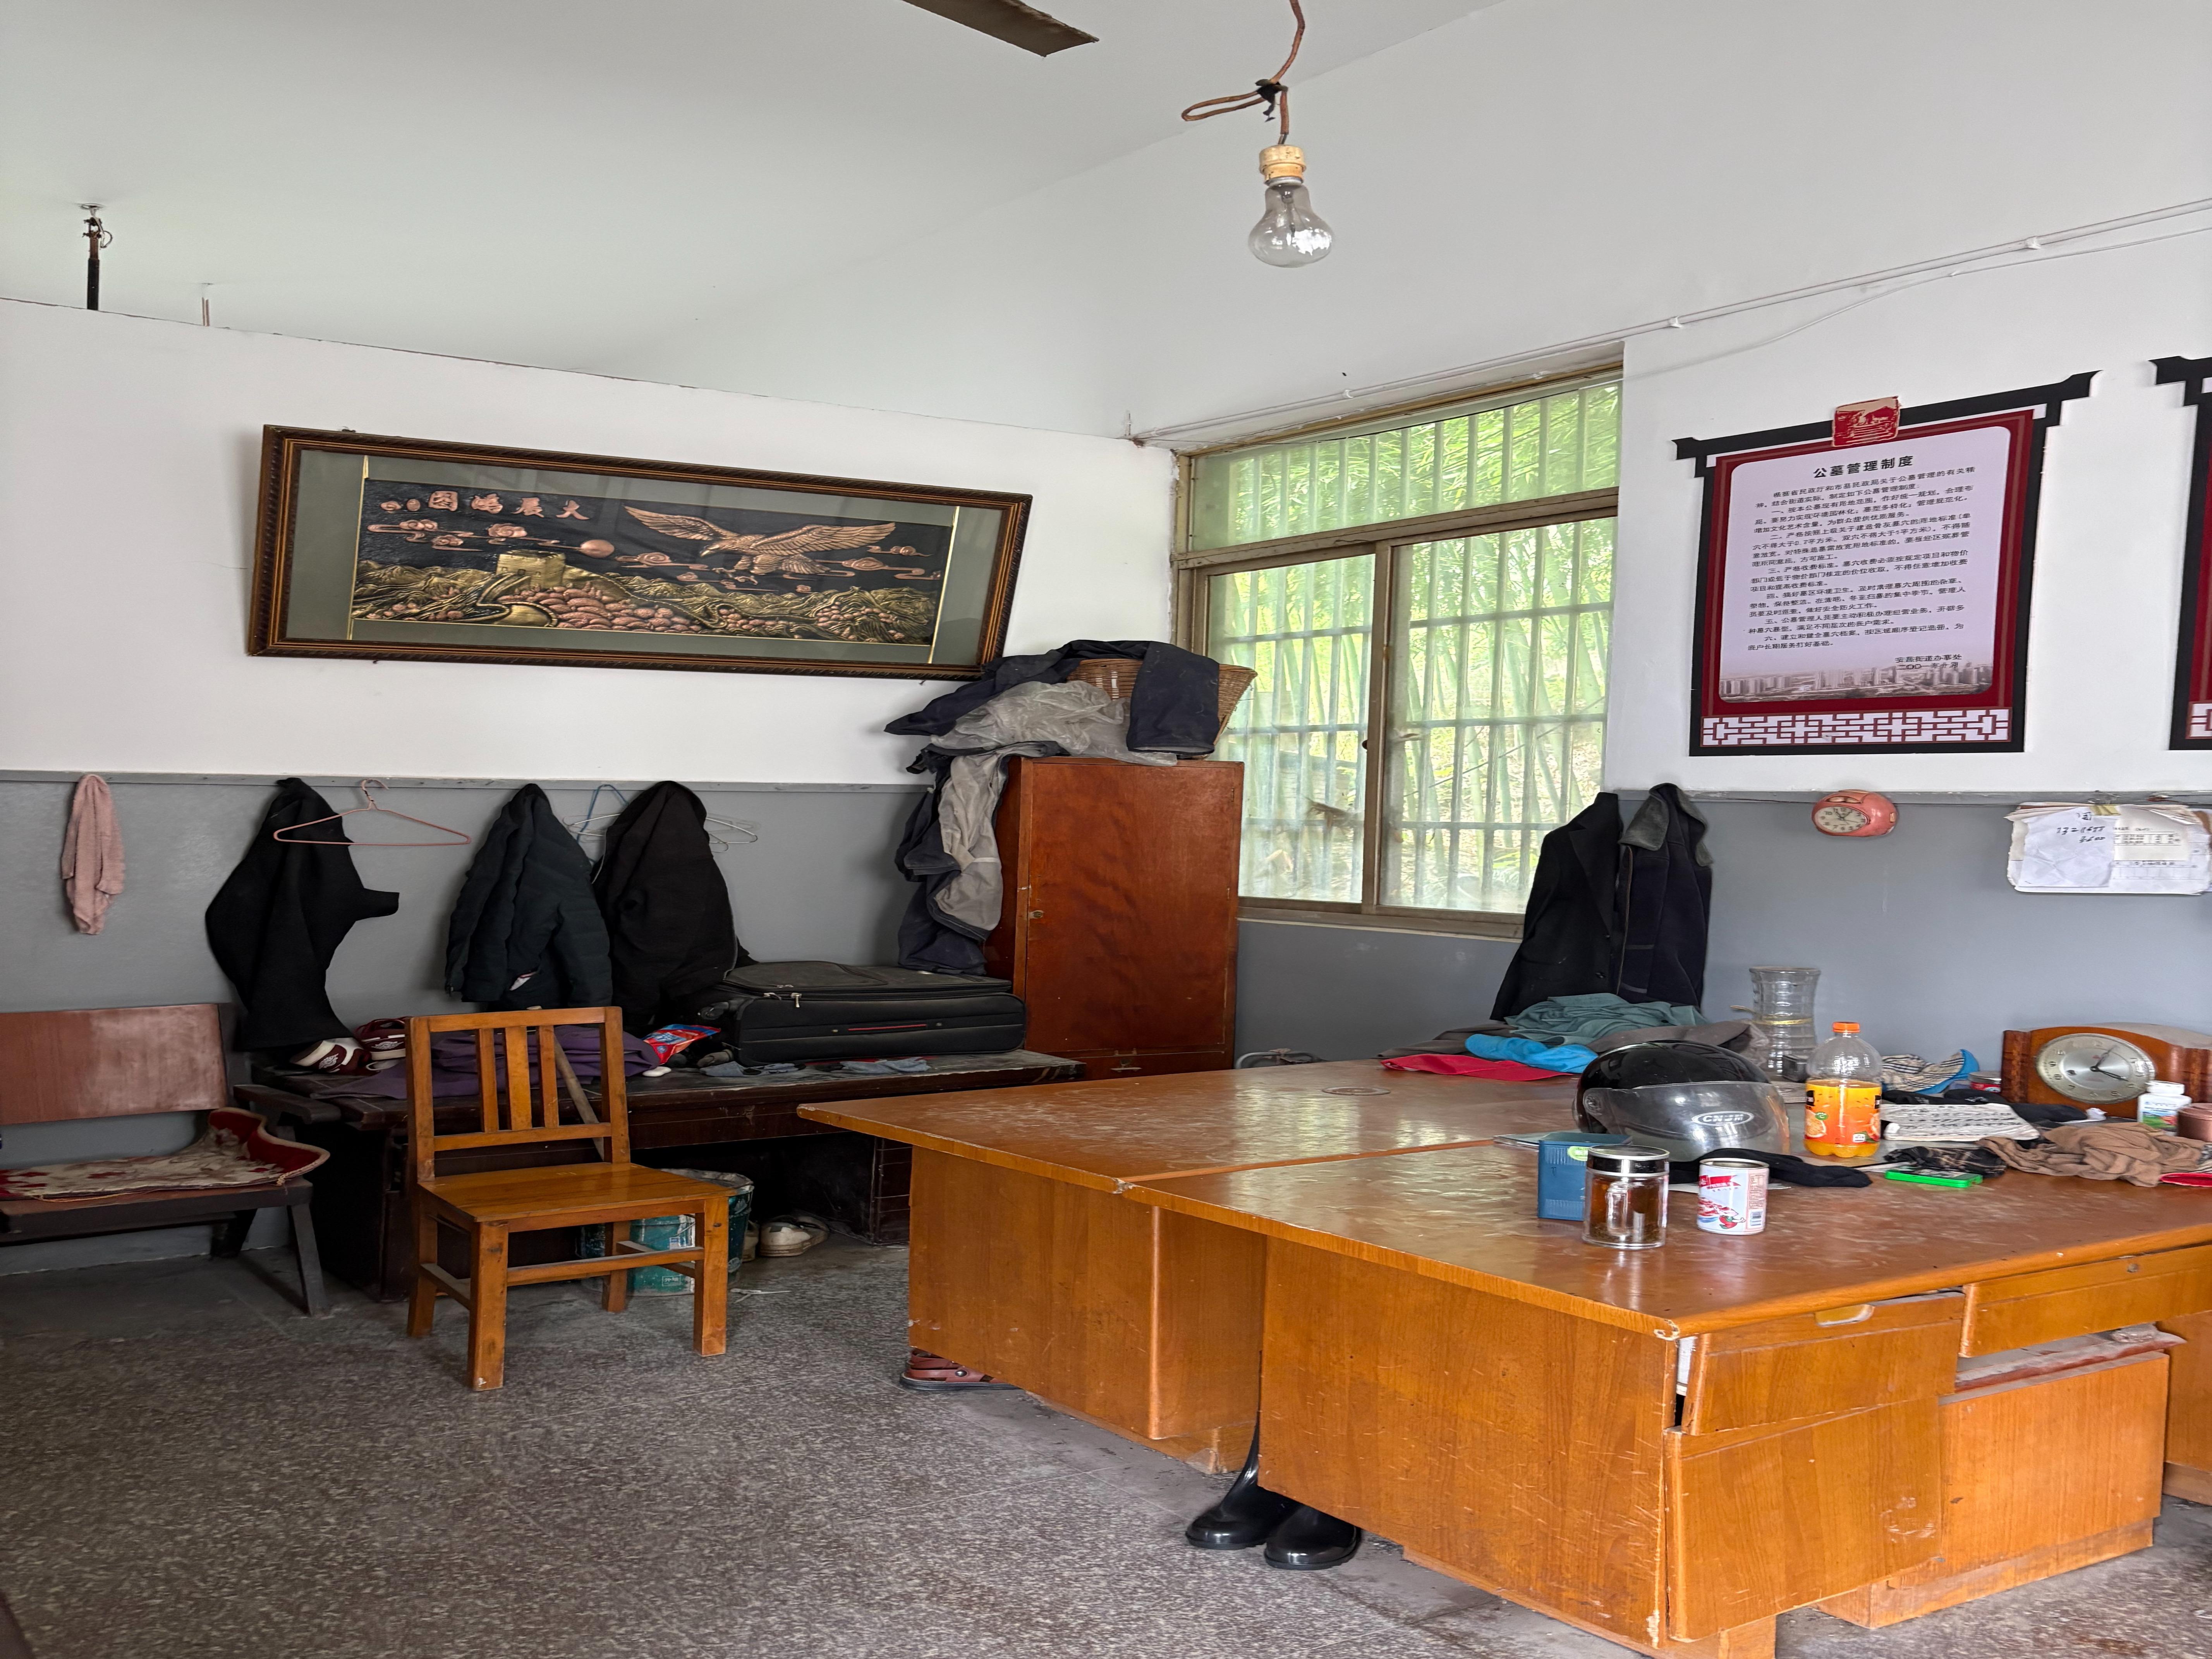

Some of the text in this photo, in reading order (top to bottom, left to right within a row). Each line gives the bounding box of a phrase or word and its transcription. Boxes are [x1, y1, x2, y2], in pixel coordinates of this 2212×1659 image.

[1813, 455, 1913, 478] 公墓管理制度
